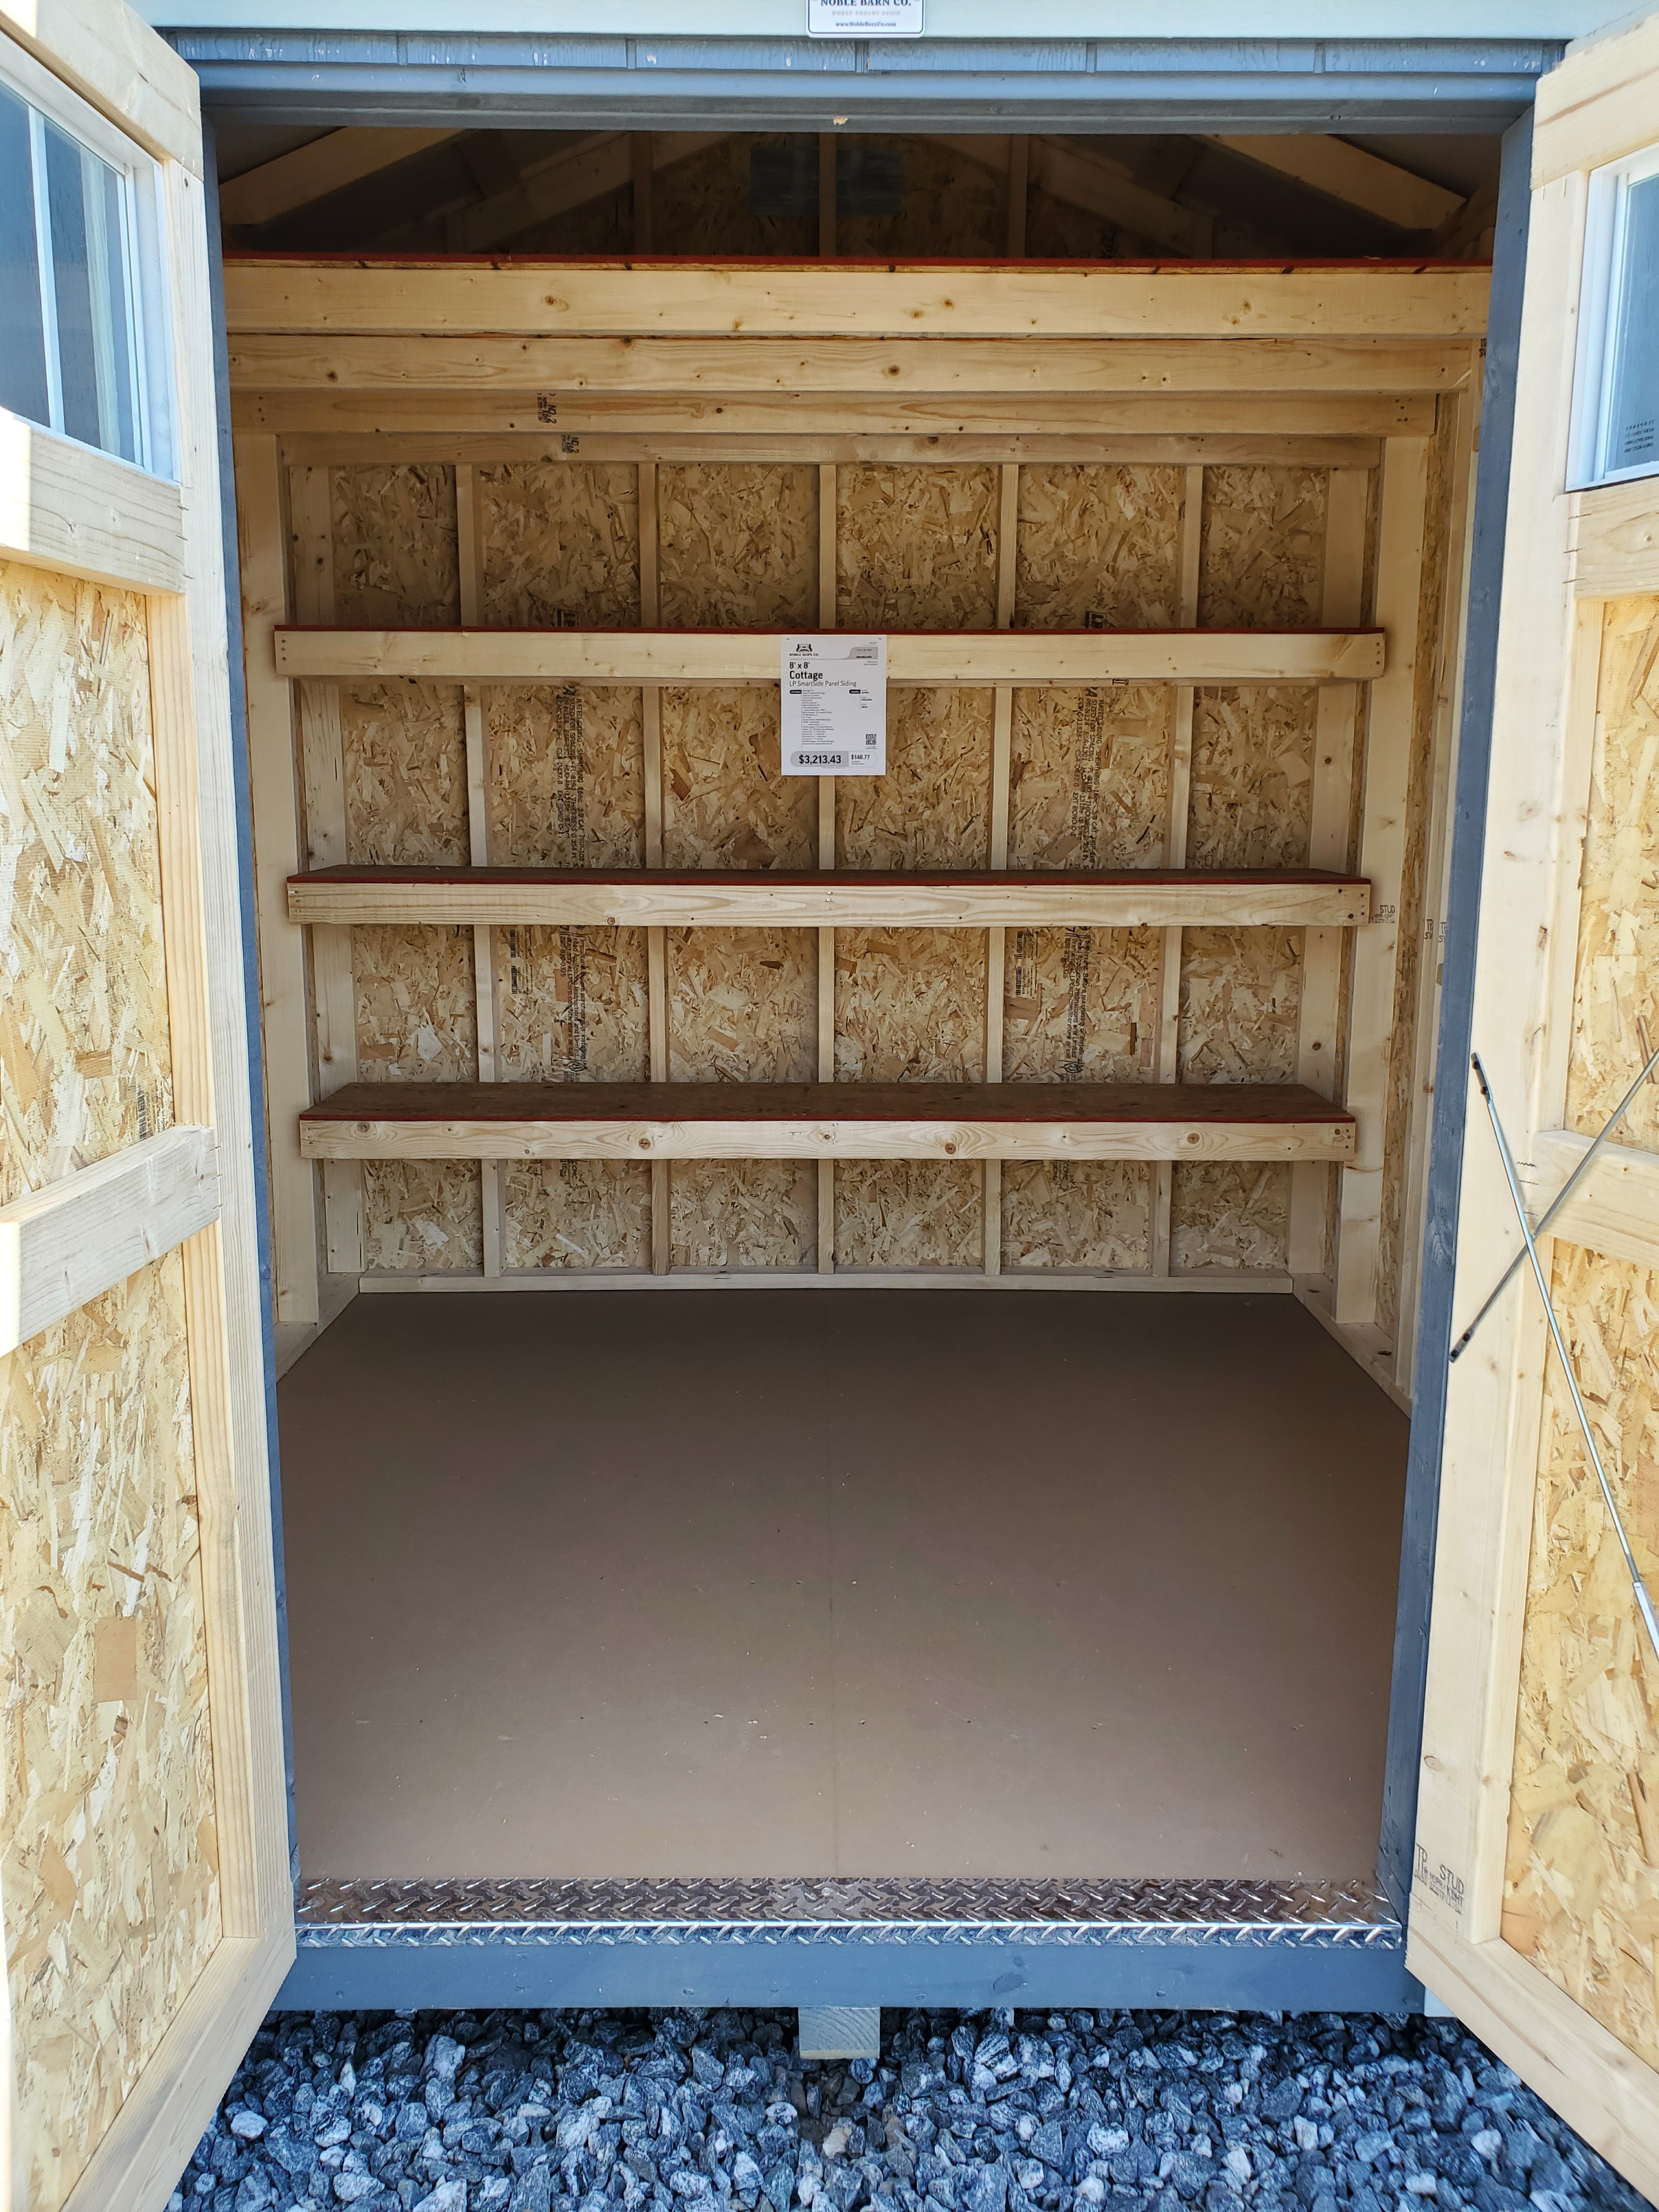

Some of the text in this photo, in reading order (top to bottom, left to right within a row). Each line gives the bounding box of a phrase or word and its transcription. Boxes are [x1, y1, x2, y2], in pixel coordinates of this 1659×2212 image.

[789, 670, 823, 681] Cottage
[799, 754, 841, 765] $3,213.43
[1380, 905, 1395, 913] STUD
[1440, 1864, 1464, 1895] STUD
